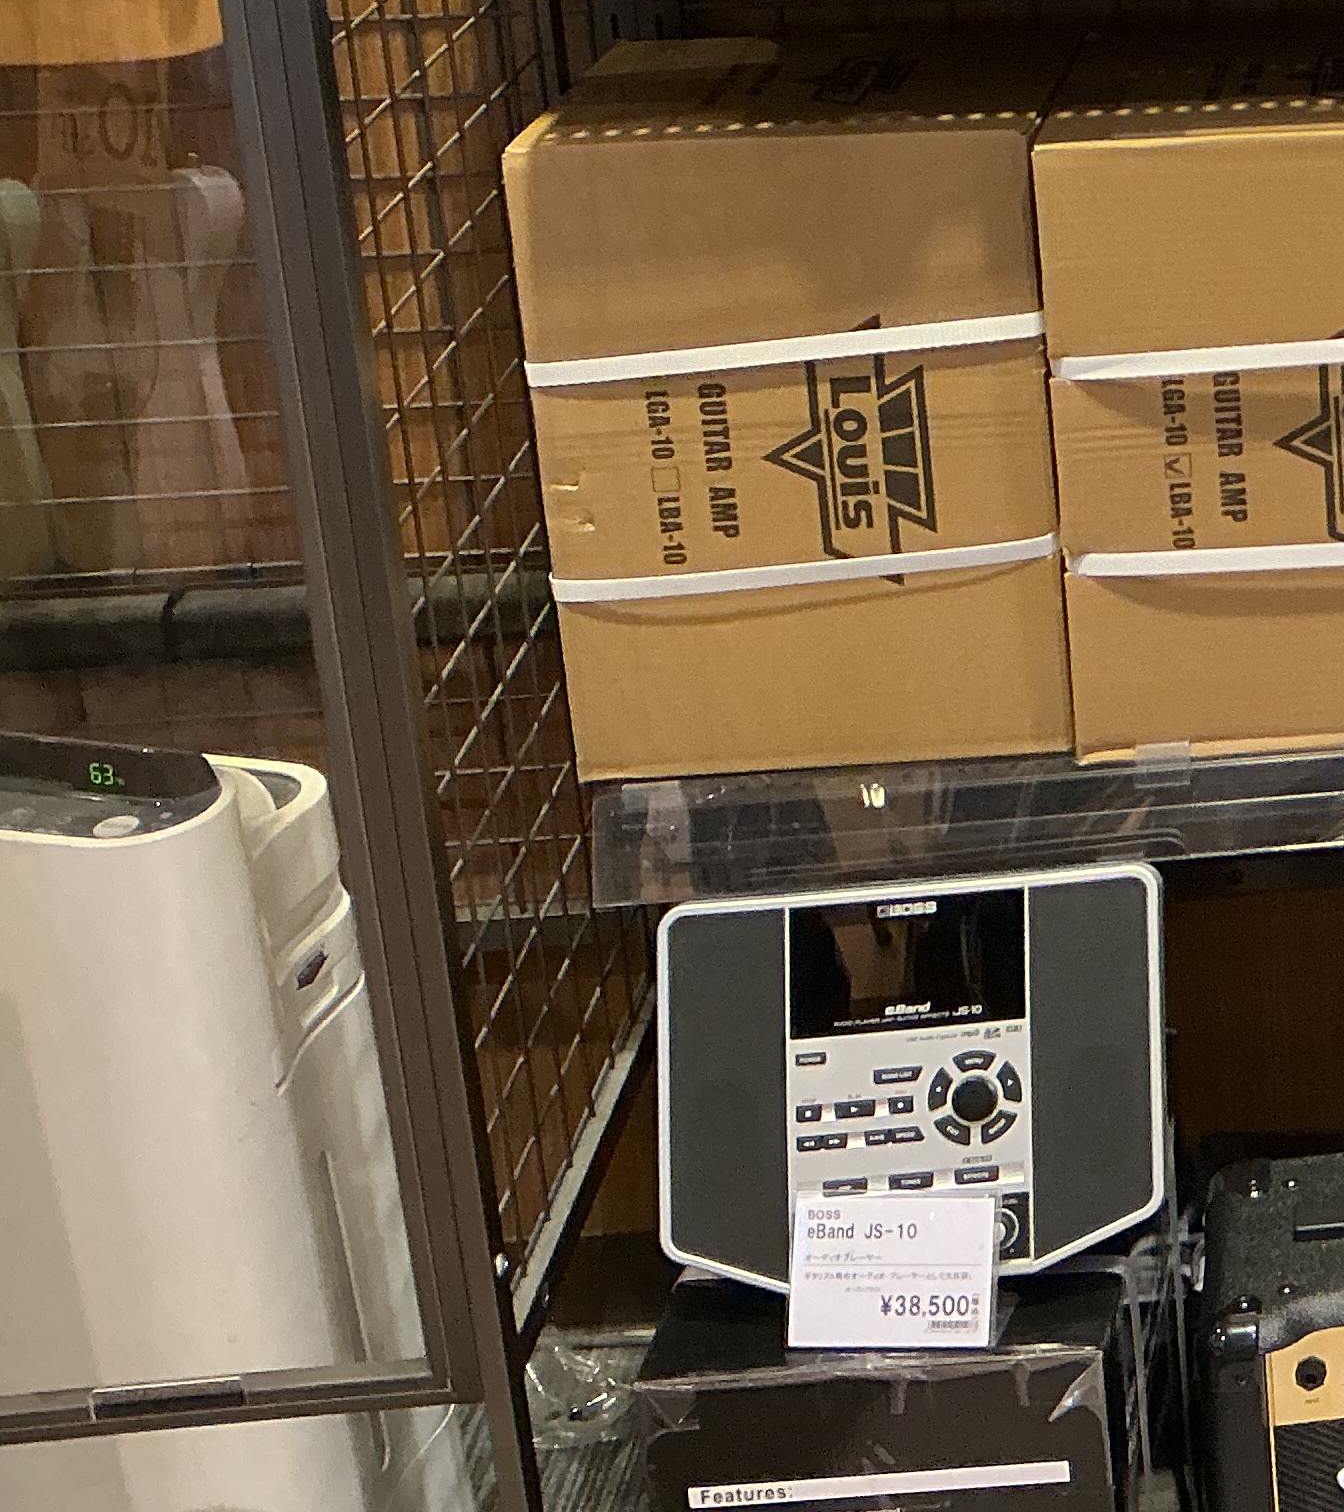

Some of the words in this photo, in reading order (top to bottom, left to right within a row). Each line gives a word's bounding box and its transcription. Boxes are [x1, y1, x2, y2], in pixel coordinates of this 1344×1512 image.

[644, 389, 675, 459] LGA-10
[698, 382, 732, 472] GUITAR
[1161, 378, 1188, 445] LGA-10
[1212, 372, 1244, 458] GUITAR
[708, 486, 741, 538] AMP
[1169, 484, 1196, 550] LBA-10
[1219, 471, 1248, 522] AMP
[657, 495, 687, 564] LBA-10
[89, 763, 114, 786] 63
[808, 1210, 841, 1220] BOSS
[808, 1223, 854, 1239] eBand
[865, 1223, 917, 1239] JS-10
[881, 1295, 969, 1316] ¥38,500
[699, 1484, 794, 1505] Features:
